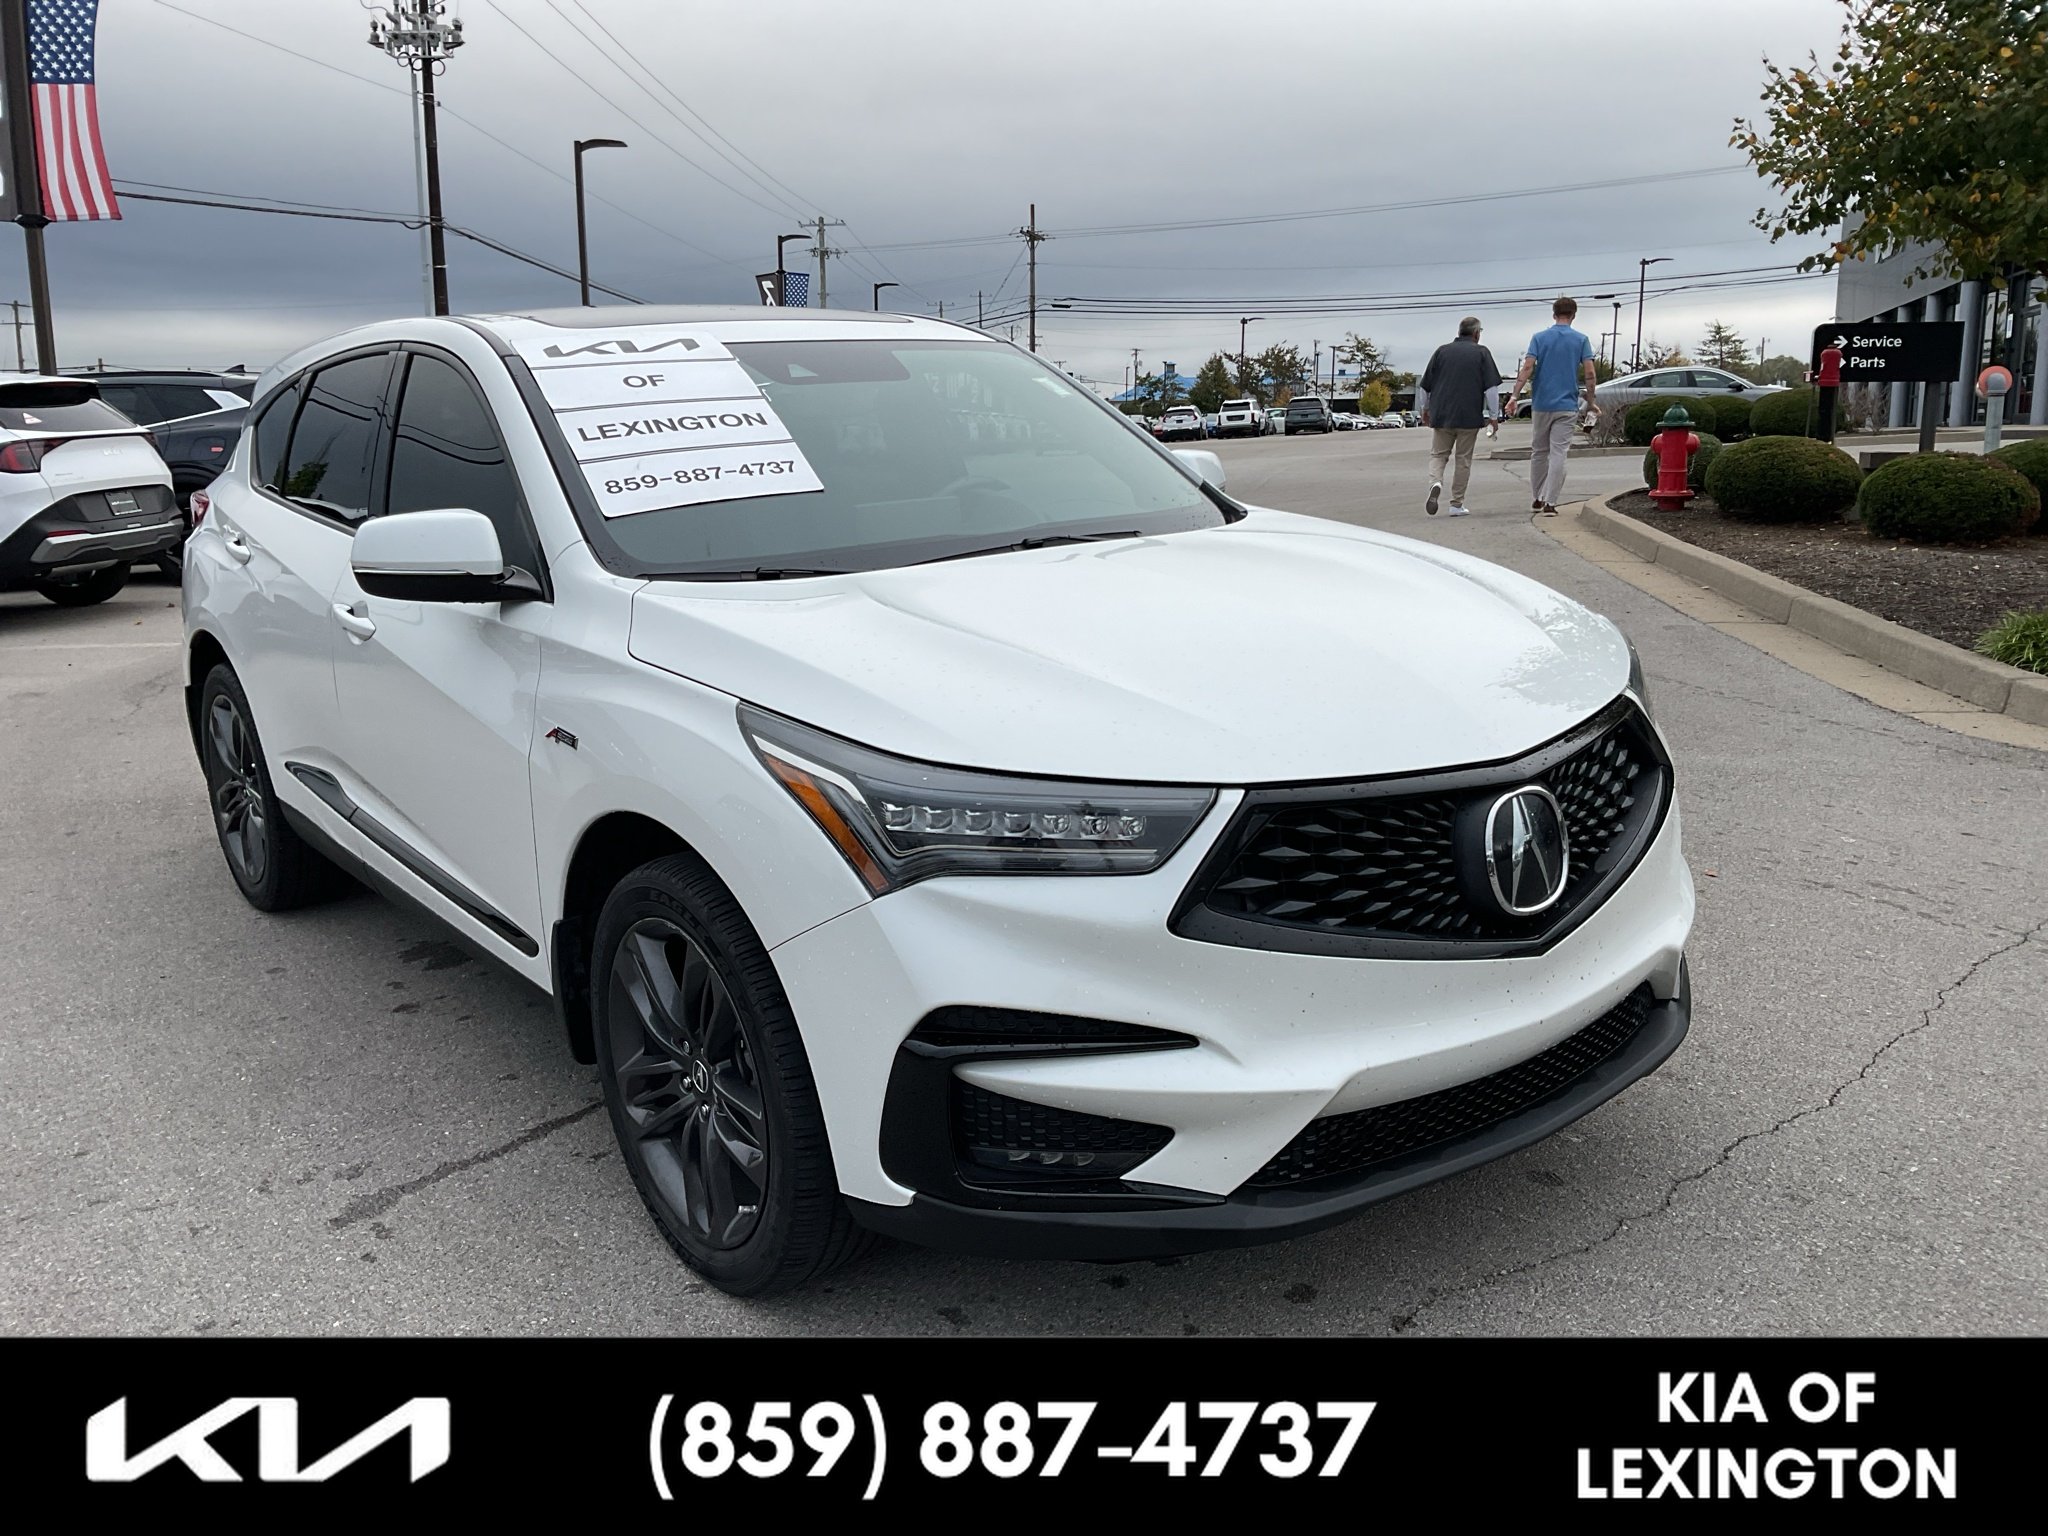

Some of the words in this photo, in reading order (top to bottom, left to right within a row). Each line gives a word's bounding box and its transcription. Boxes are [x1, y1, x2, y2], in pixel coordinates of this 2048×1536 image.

[543, 338, 701, 358] KIA
[1852, 335, 1903, 348] Service
[1850, 356, 1886, 368] Parts
[622, 375, 666, 388] OF
[577, 412, 768, 442] LEXINGTON
[604, 460, 796, 495] 859-887-4737
